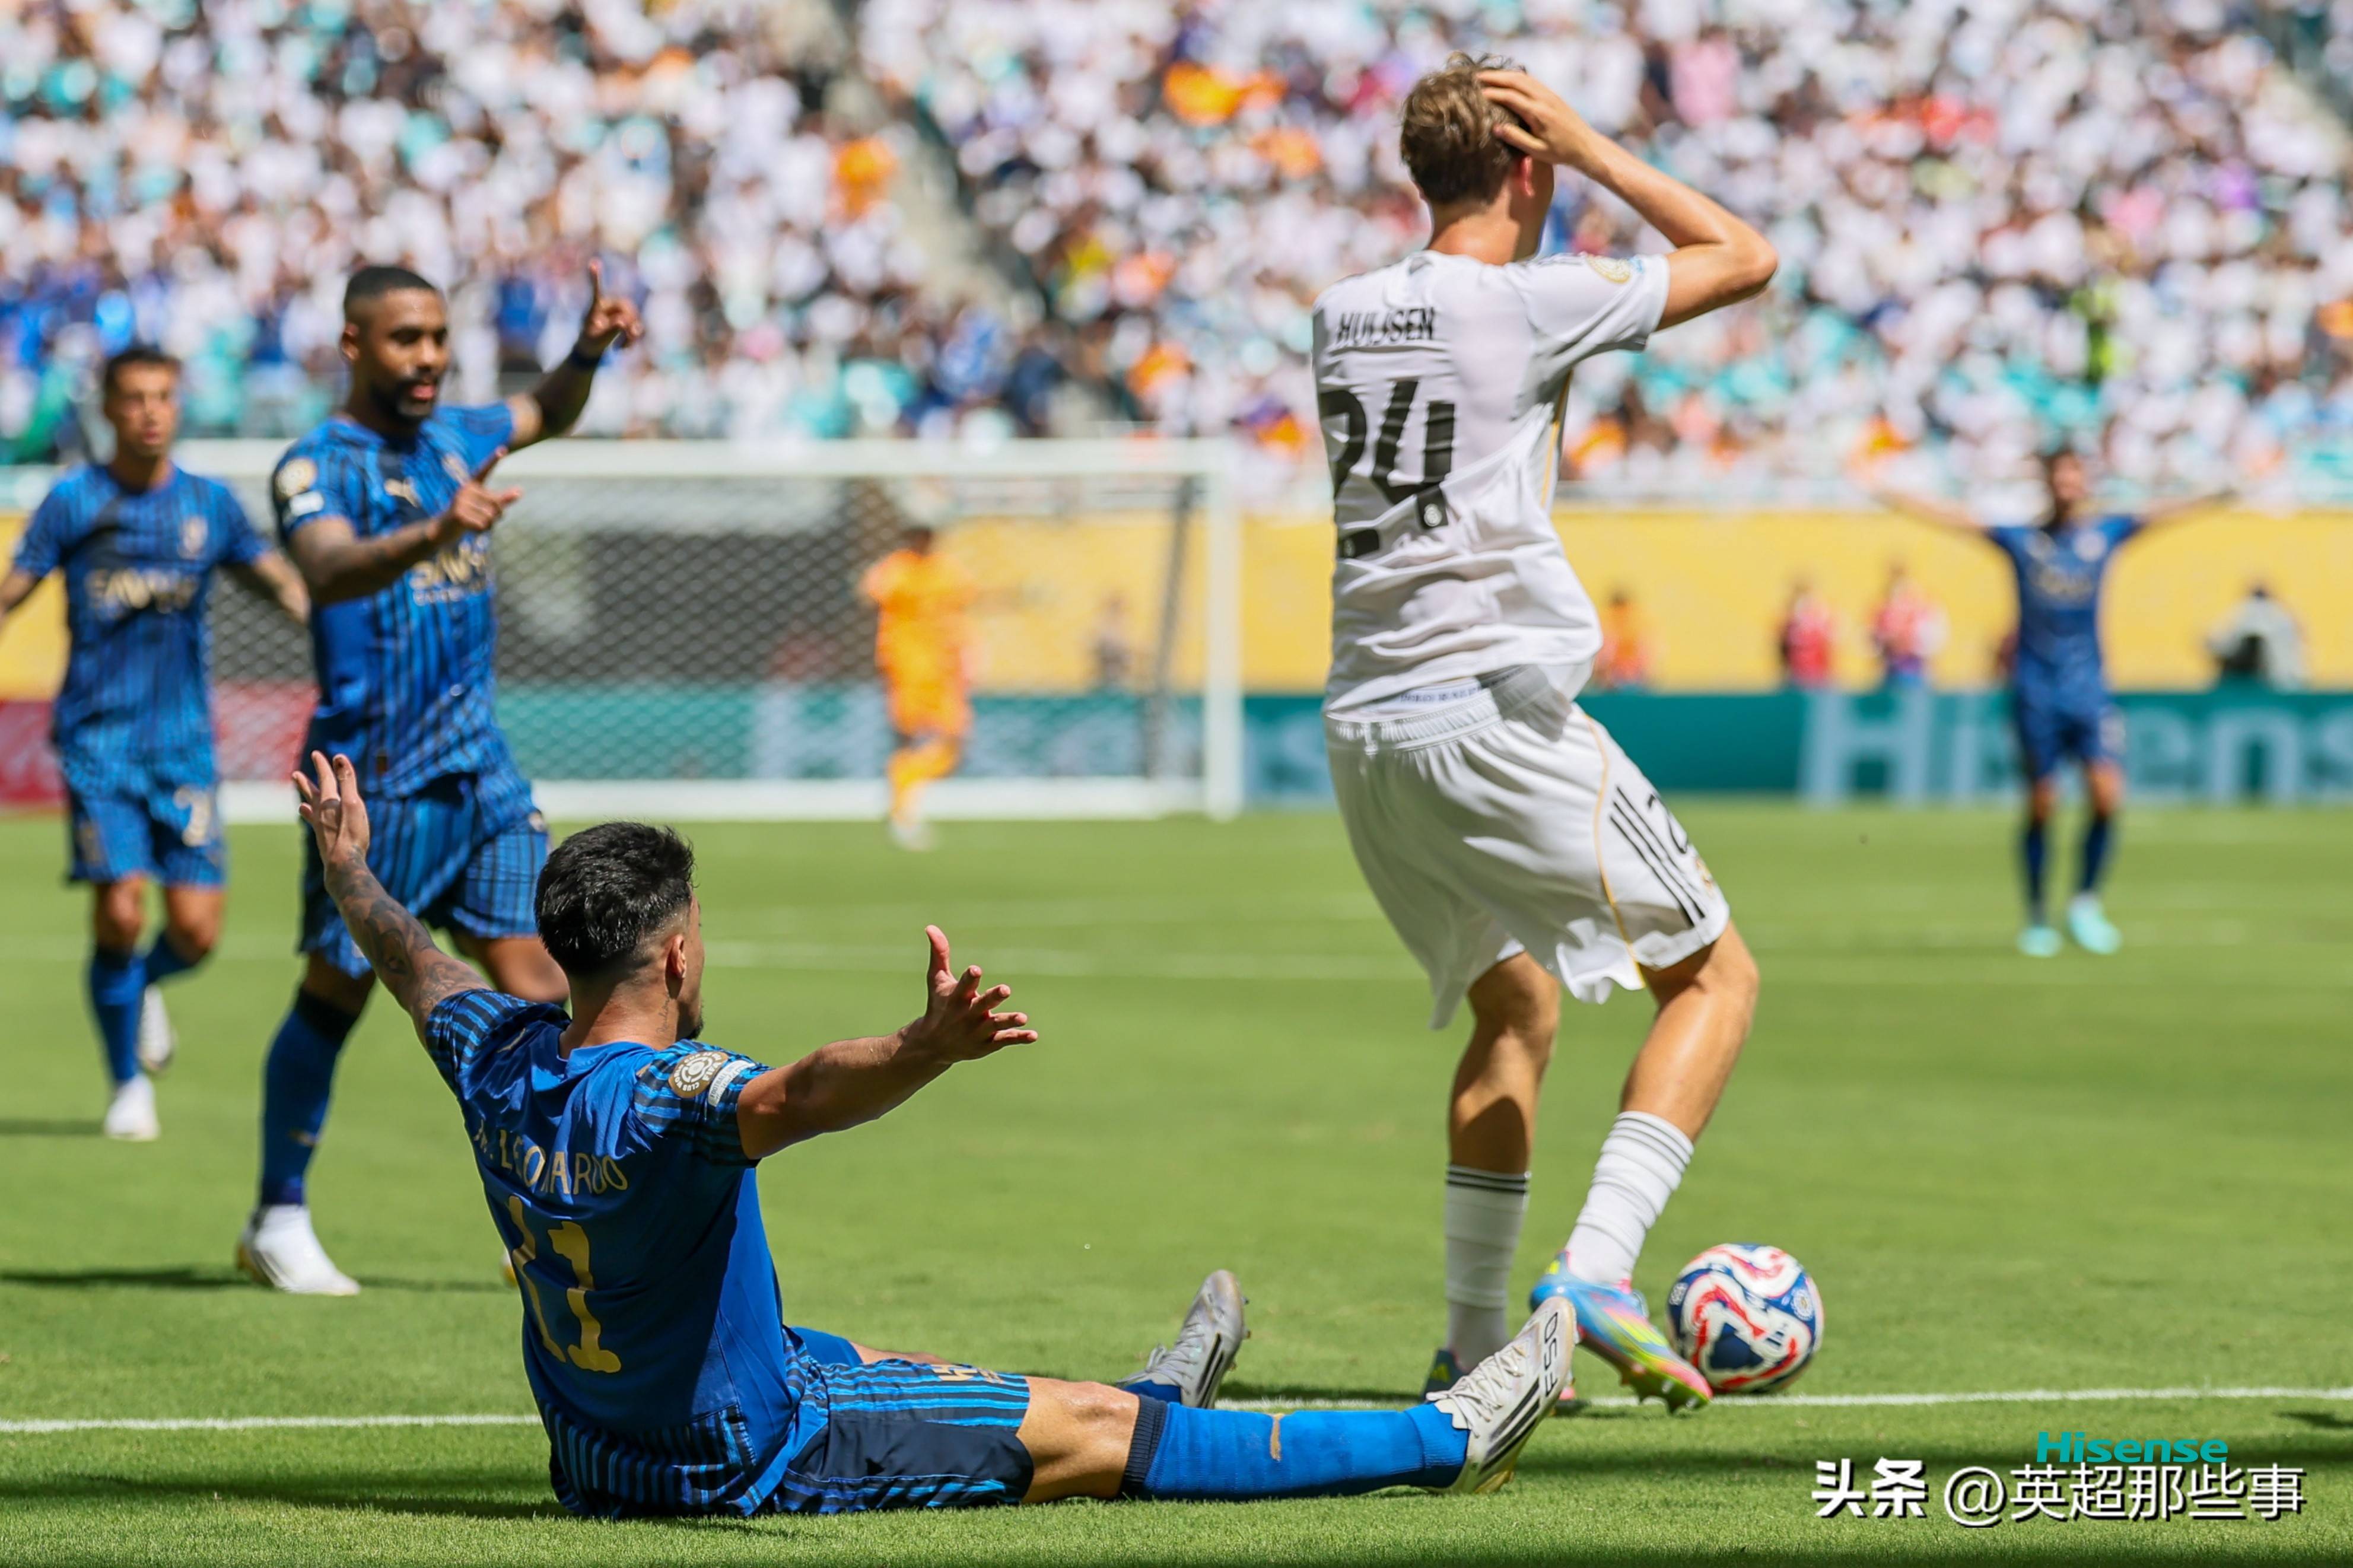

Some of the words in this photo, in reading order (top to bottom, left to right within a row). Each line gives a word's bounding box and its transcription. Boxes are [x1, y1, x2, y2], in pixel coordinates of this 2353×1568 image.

[1320, 380, 1455, 559] 24
[682, 1082, 699, 1092] CLUB
[702, 1063, 722, 1081] FIFA
[500, 1129, 628, 1195] LEOARDO
[508, 1195, 621, 1373] 11
